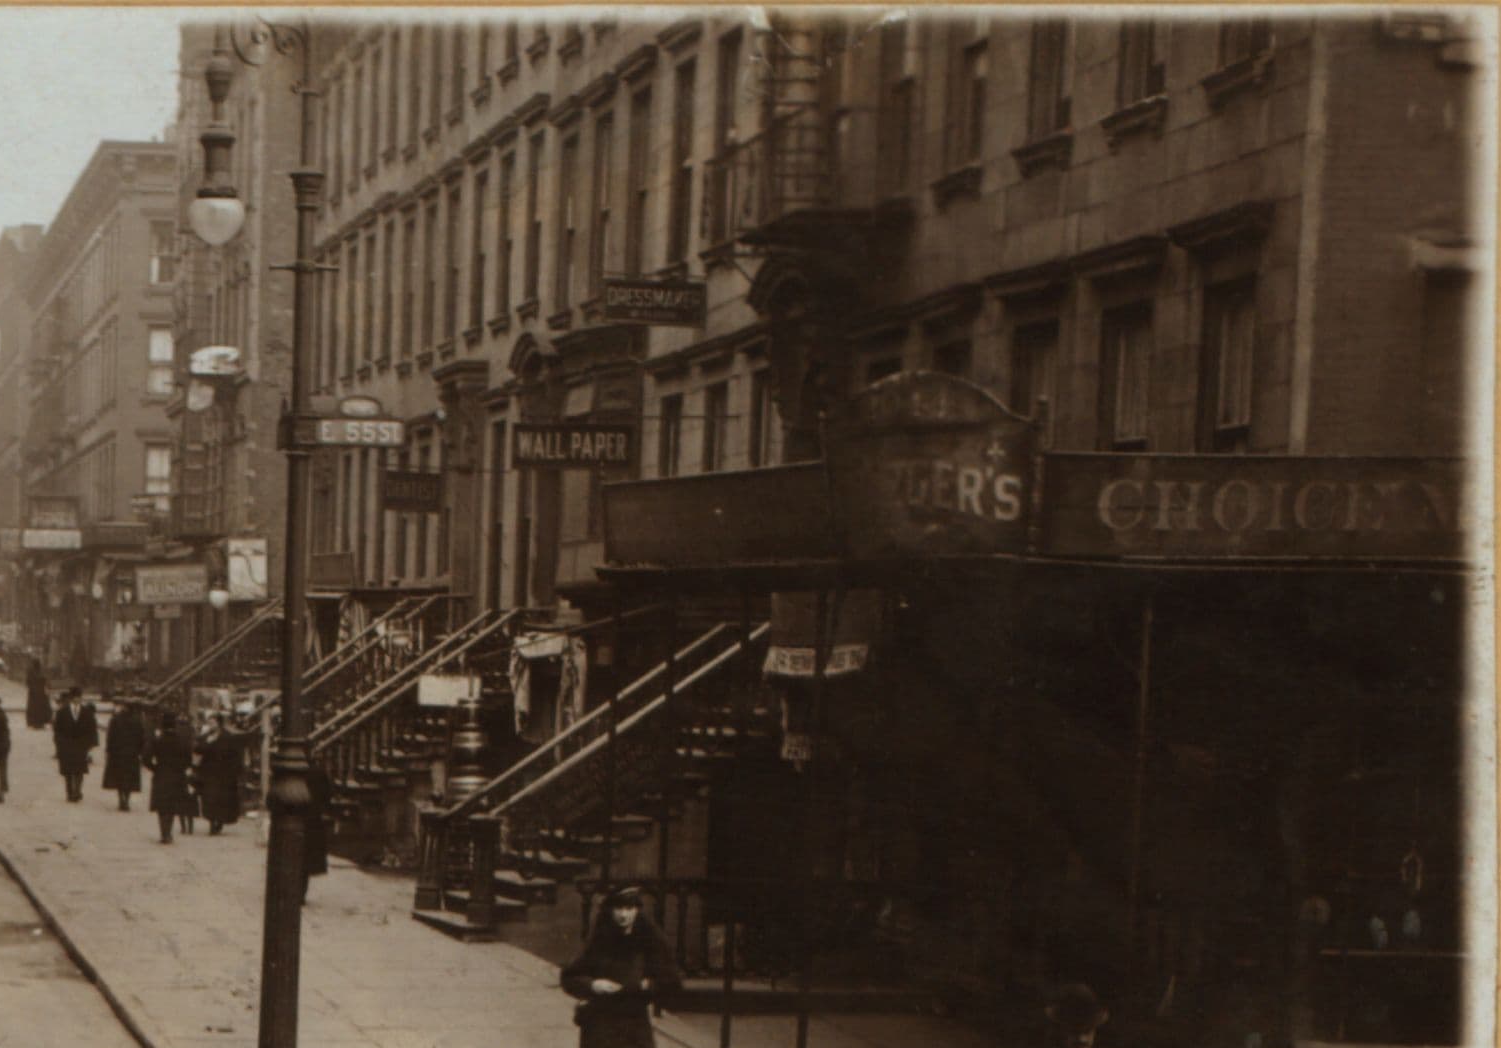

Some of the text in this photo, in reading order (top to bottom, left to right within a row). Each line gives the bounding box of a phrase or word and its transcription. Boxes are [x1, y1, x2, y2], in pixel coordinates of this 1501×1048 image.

[517, 431, 627, 461] WALL PAPER
[1097, 479, 1386, 532] CHOICE
